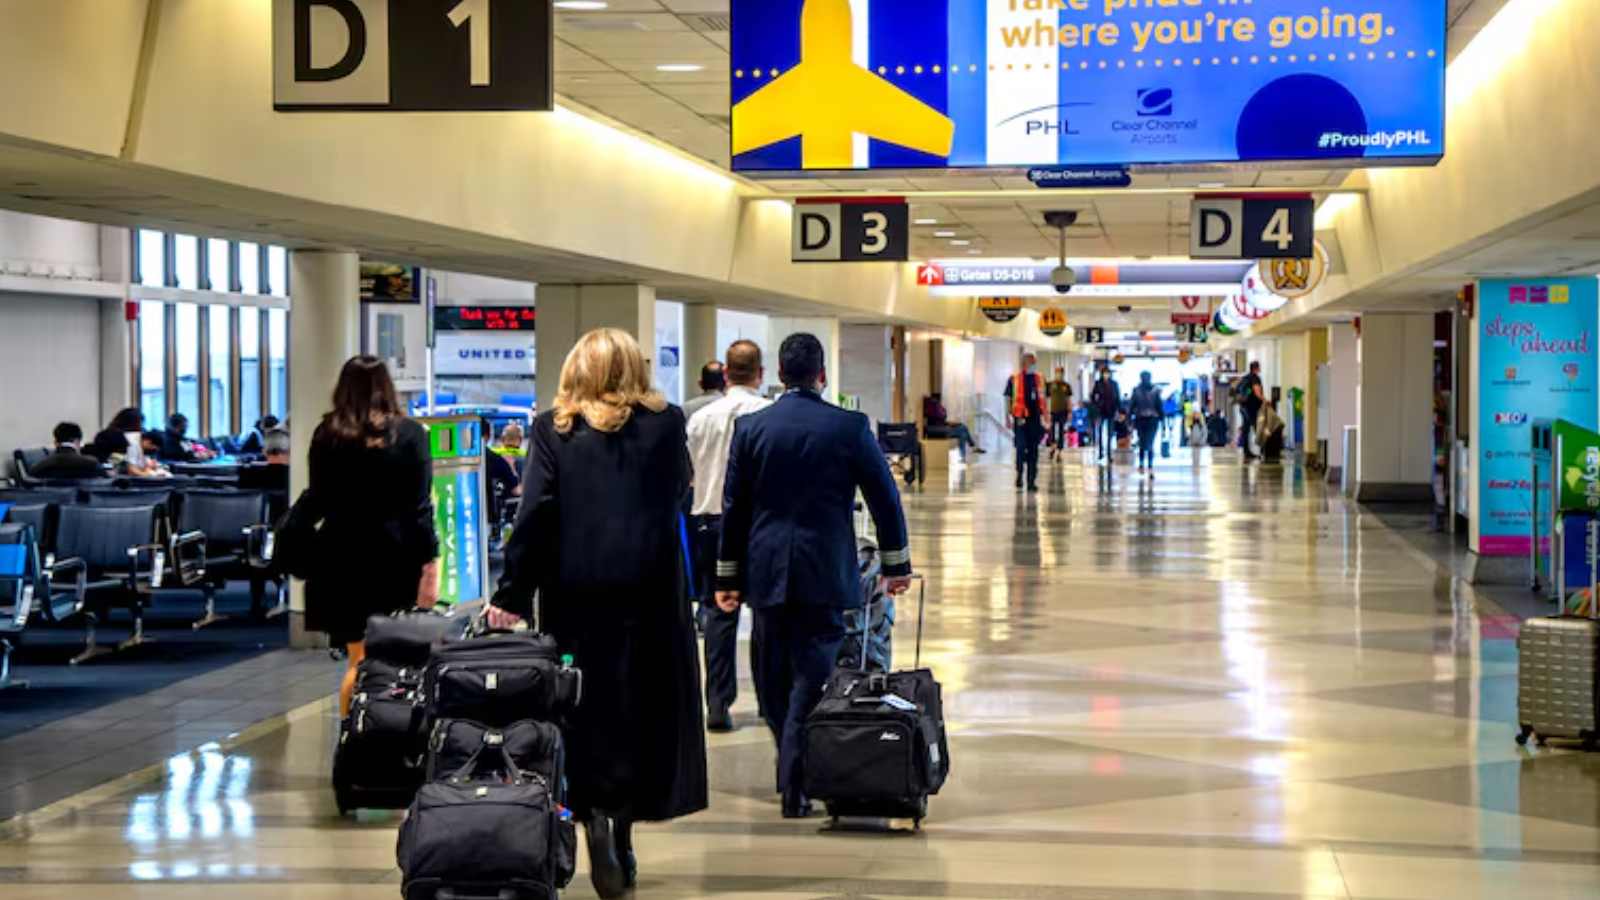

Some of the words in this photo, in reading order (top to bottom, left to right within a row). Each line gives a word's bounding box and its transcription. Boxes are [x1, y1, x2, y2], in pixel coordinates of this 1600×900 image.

[294, 0, 367, 82] D
[447, 0, 491, 86] 1
[1000, 18, 1120, 48] where
[1131, 11, 1256, 52] you’re
[1268, 7, 1395, 48] going.
[1026, 119, 1080, 136] PHL
[1111, 121, 1144, 132] Clear
[1146, 118, 1198, 131] Channel
[1318, 129, 1431, 149] #ProudlyPHL
[1130, 134, 1178, 145] Airports
[801, 212, 831, 250] D
[861, 210, 888, 254] 3
[1199, 207, 1233, 248] D
[1261, 207, 1294, 250] 4
[960, 268, 991, 281] Gates
[1486, 313, 1536, 347] steps
[1521, 331, 1589, 353] ahead
[458, 348, 527, 359] UNITED
[1583, 446, 1600, 508] recycle
[444, 484, 458, 597] recycle
